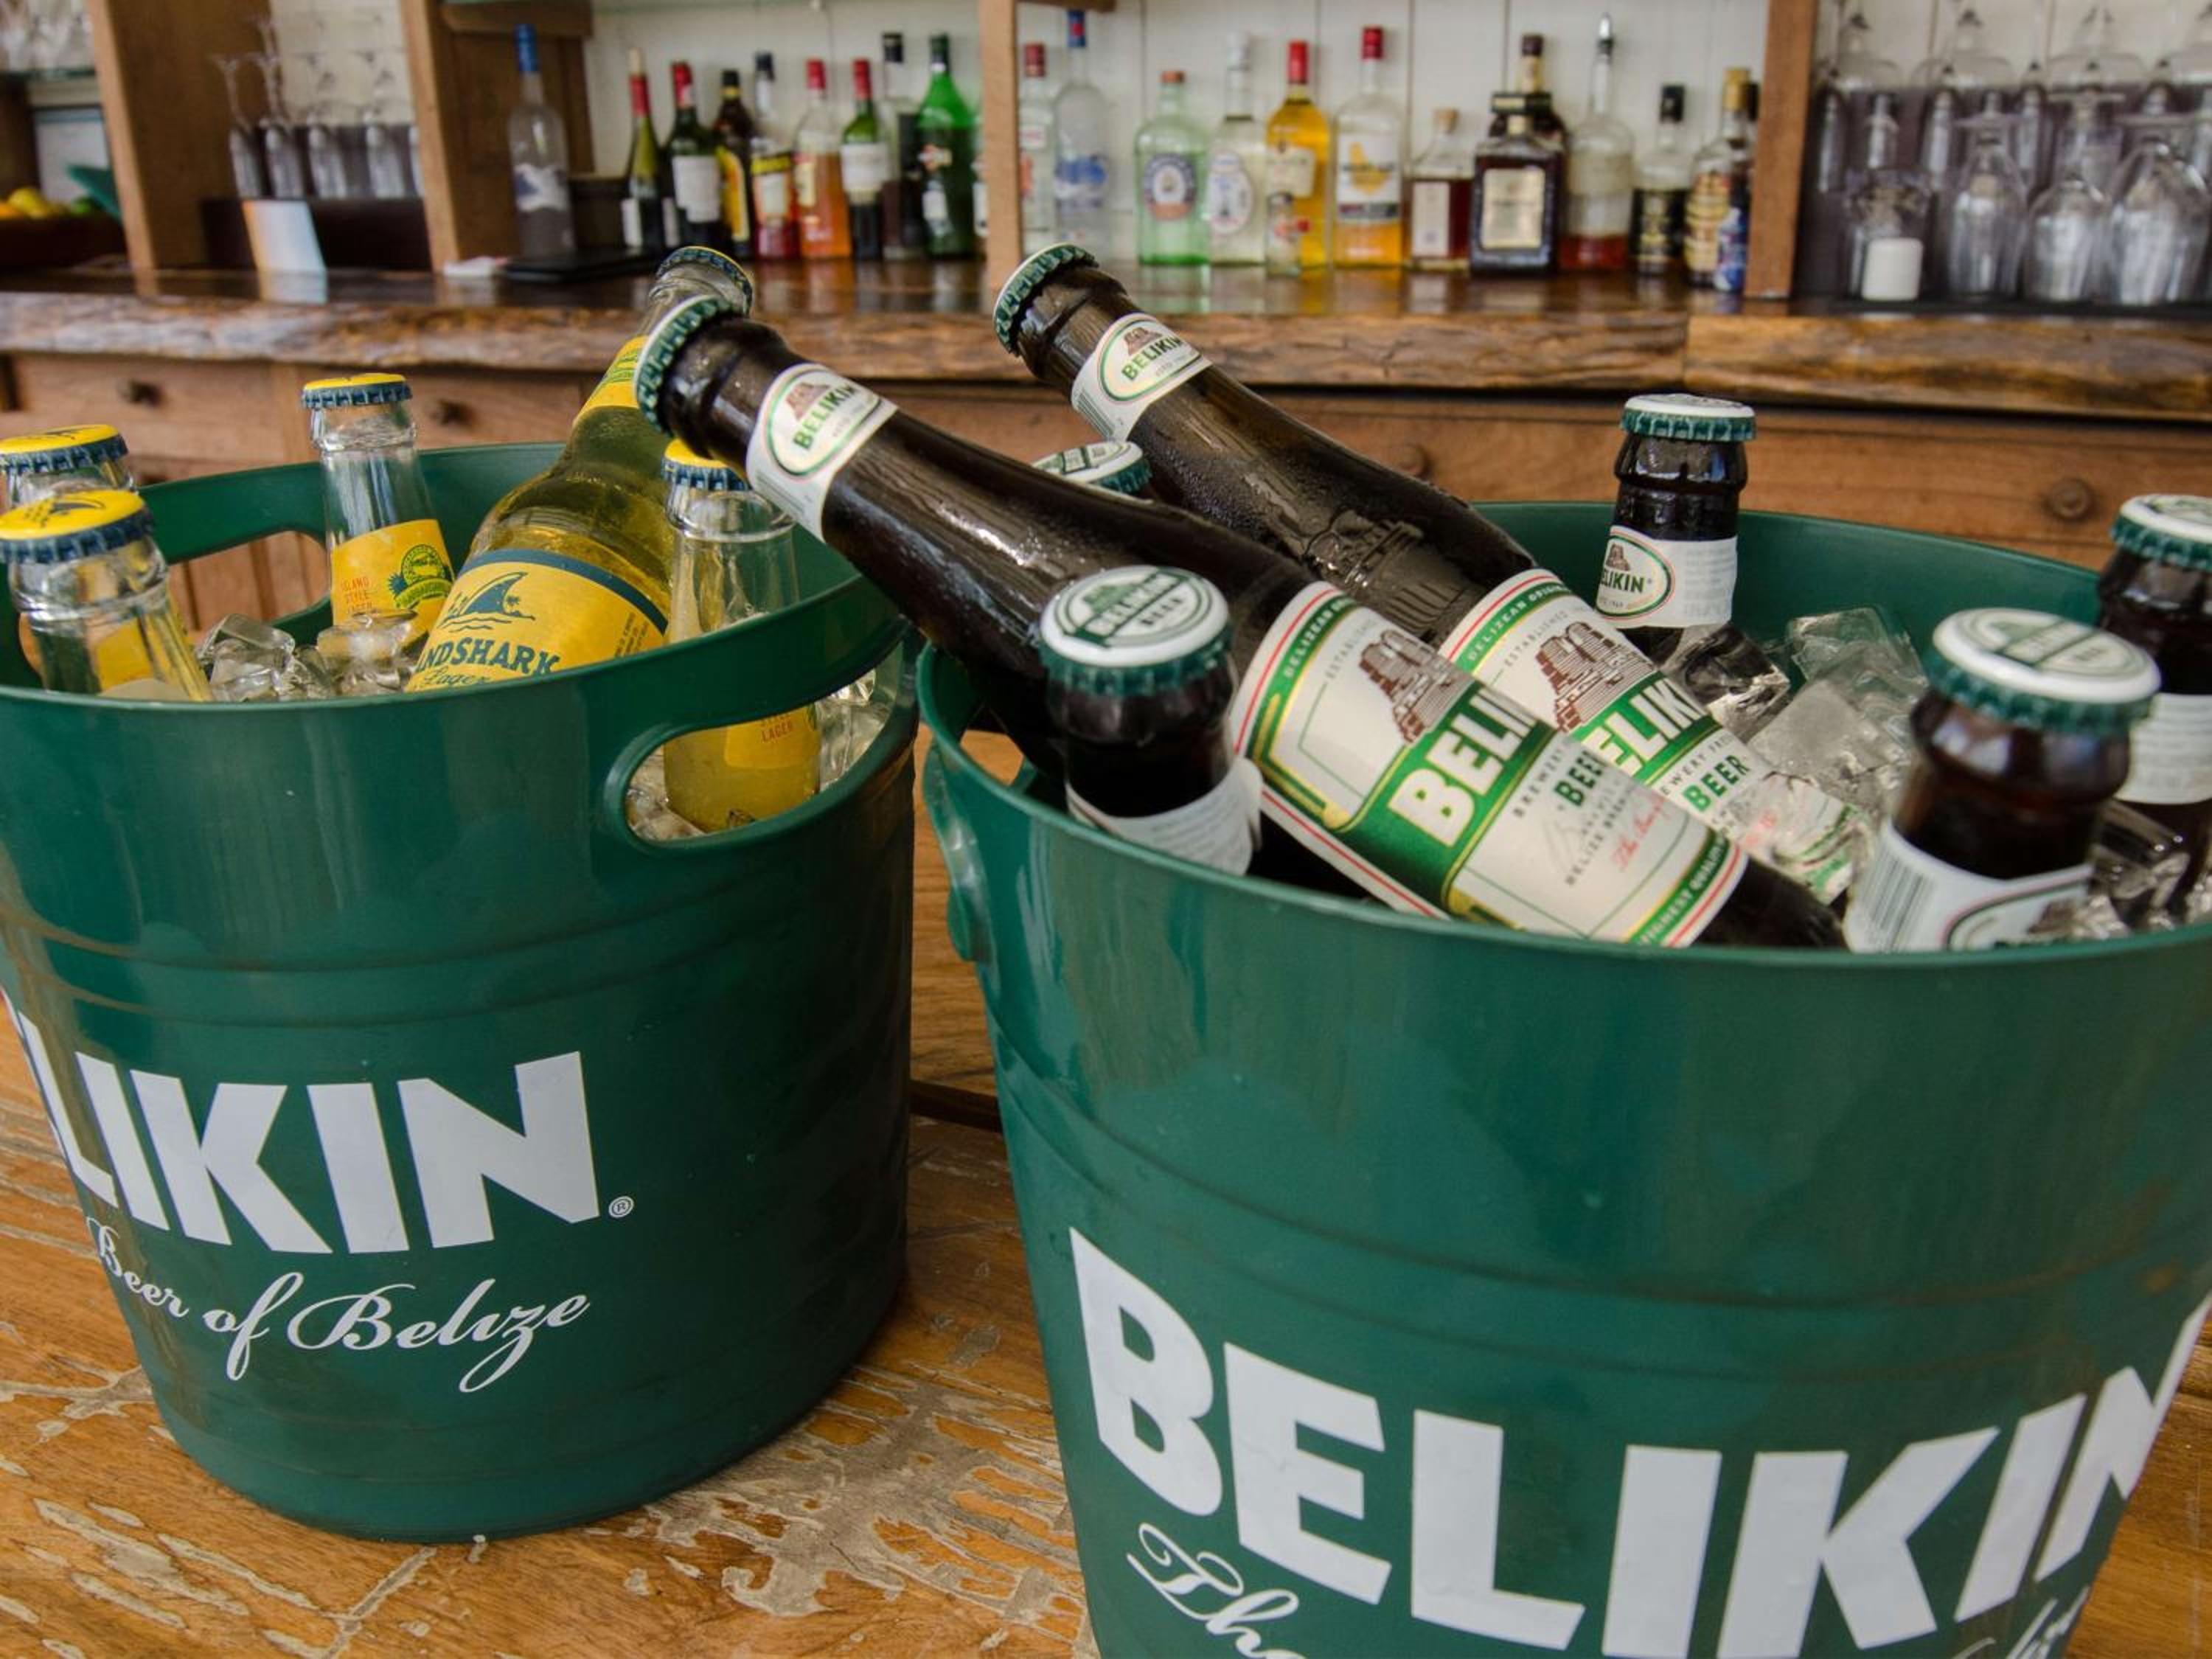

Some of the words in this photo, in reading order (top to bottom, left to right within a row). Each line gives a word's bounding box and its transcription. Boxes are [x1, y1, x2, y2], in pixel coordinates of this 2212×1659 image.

[792, 383, 858, 450] BELIKIN
[1121, 335, 1182, 381] BELIKIN
[1386, 687, 1538, 848] BELI
[1660, 753, 1707, 796] EWERY
[1683, 754, 1750, 812] BEER
[18, 1009, 600, 1254] LIKIN
[202, 1272, 304, 1381] of
[287, 1278, 591, 1393] Belize
[1069, 1226, 2212, 1658] BELIKIN
[1126, 1522, 1307, 1659] Th
